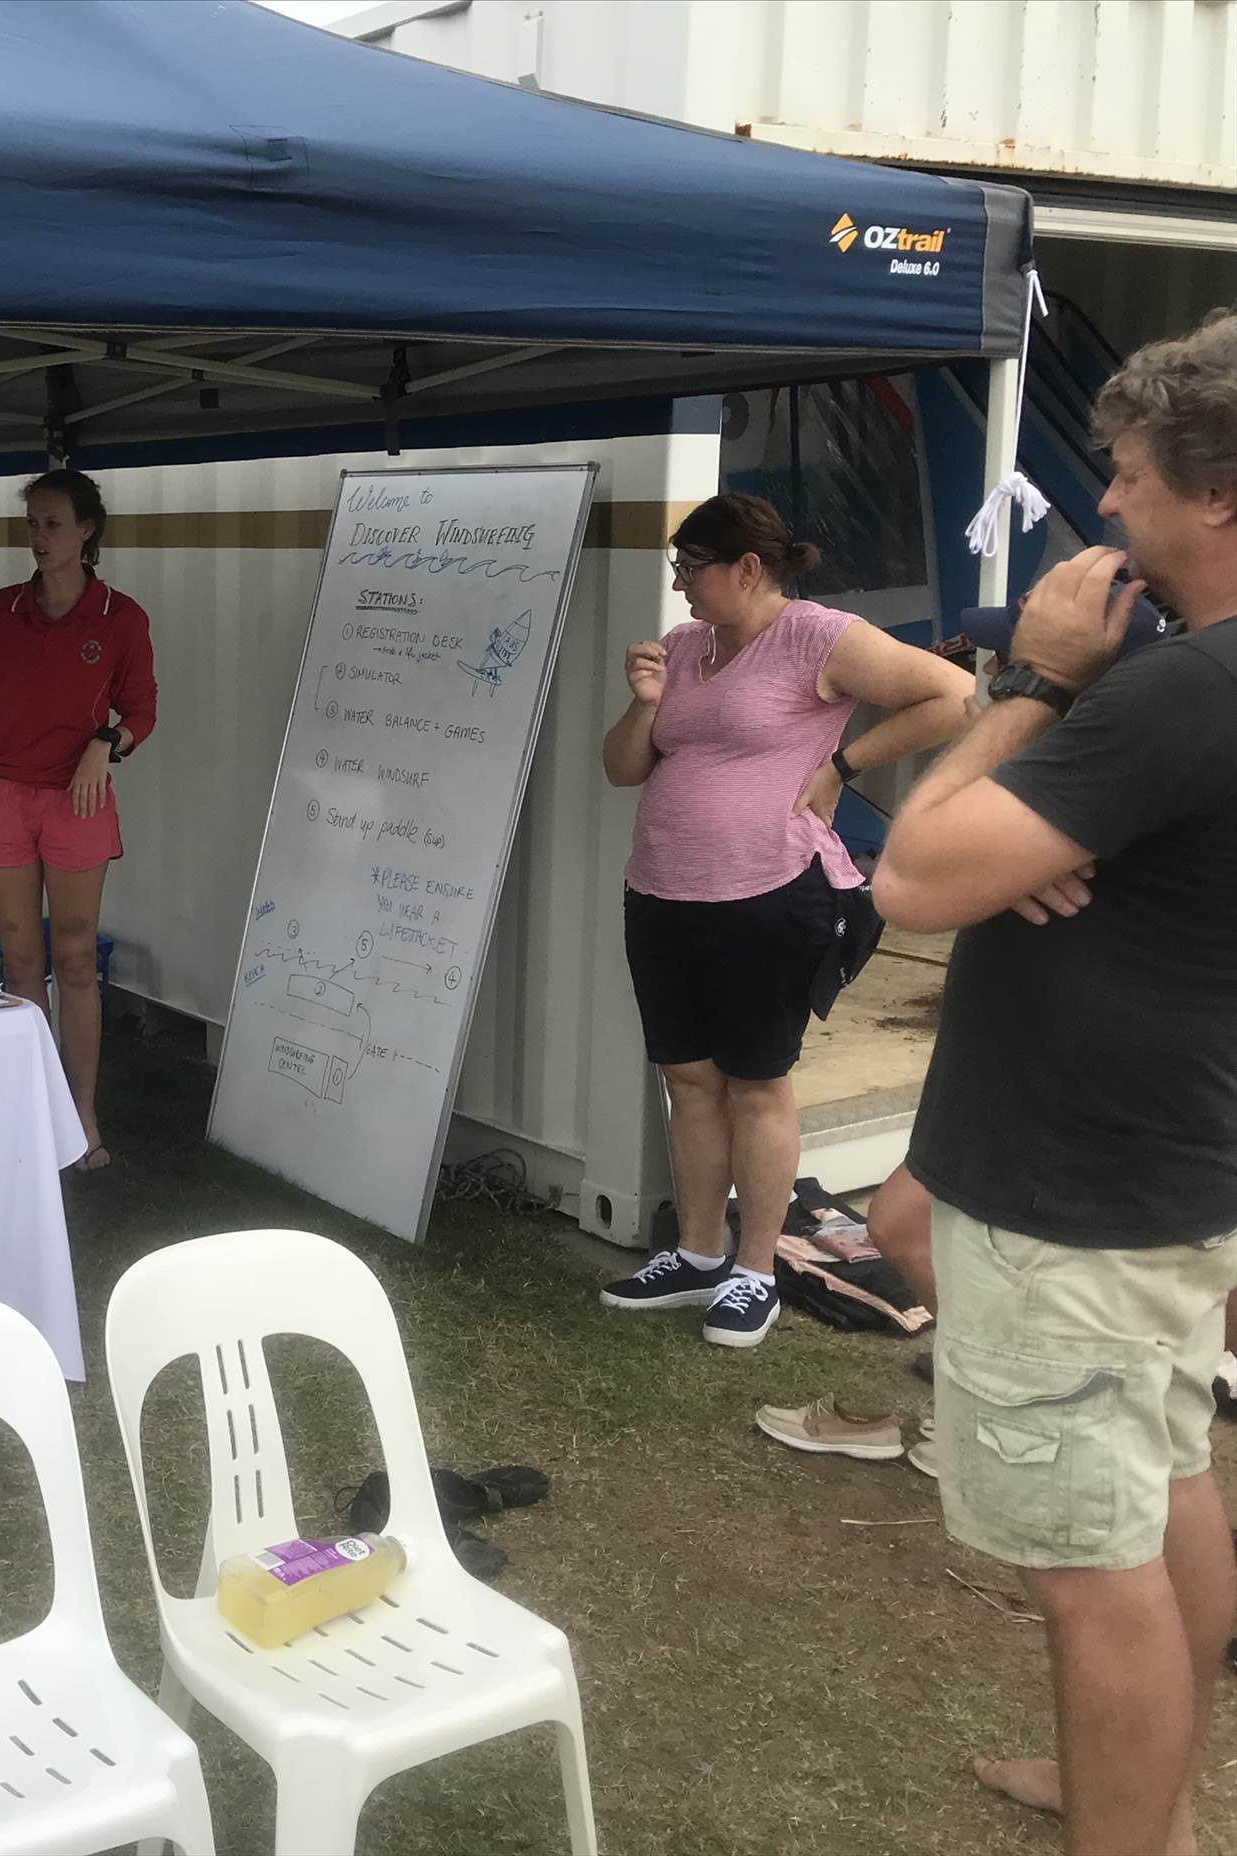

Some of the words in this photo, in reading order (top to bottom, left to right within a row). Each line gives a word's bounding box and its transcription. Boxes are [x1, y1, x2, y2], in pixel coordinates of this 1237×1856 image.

[863, 225, 945, 253] OZtrail
[889, 258, 922, 275] Deluxe
[923, 261, 941, 276] 6.0
[347, 485, 411, 513] Welcome
[420, 487, 434, 505] to
[349, 522, 422, 547] DISCOVER
[434, 518, 537, 550] WINDSURFING
[357, 589, 424, 608] STATIONS:
[356, 625, 427, 645] REGISTRATION
[432, 634, 465, 651] DESK
[349, 665, 403, 686] SIMULATOR
[343, 707, 375, 726] WATER
[385, 713, 432, 733] BALANCE
[444, 724, 487, 744] GAMES
[333, 755, 365, 774] WATER
[377, 763, 431, 788] WINDSURF
[325, 807, 358, 830] Stand
[361, 818, 374, 840] up
[376, 819, 419, 844] paddle
[425, 879, 475, 901] ENSURE
